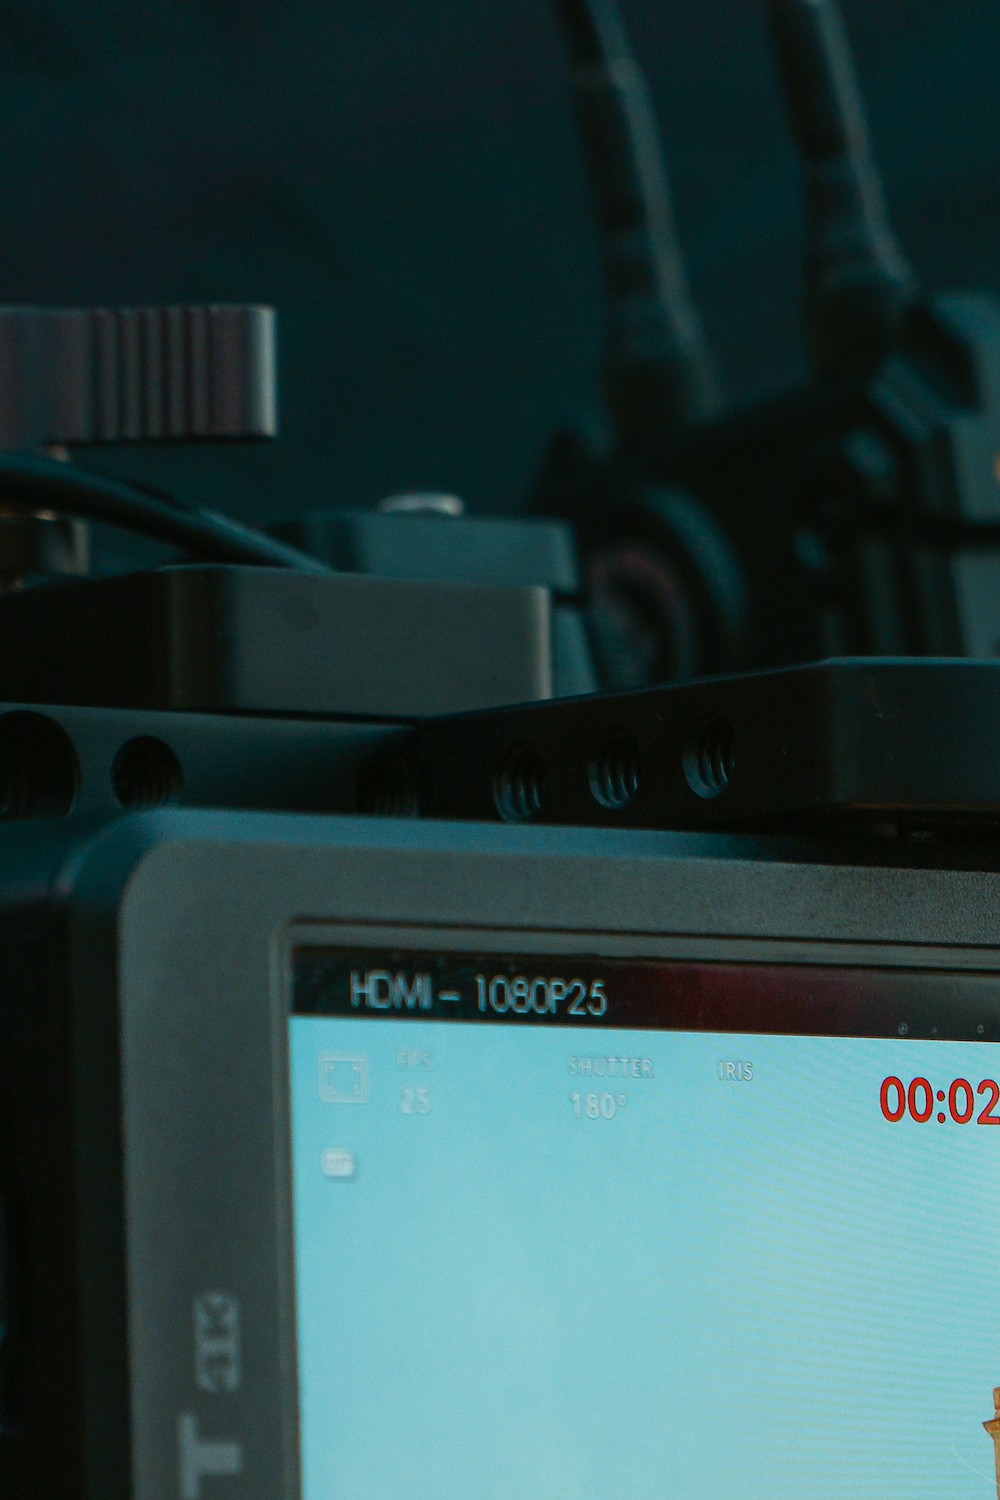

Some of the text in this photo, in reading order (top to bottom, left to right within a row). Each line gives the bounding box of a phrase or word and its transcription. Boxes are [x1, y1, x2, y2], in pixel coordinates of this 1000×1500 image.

[351, 969, 433, 1009] HDMI
[475, 973, 608, 1017] 1080P25
[568, 1055, 654, 1079] SHUTTER
[718, 1060, 754, 1083] IRIS
